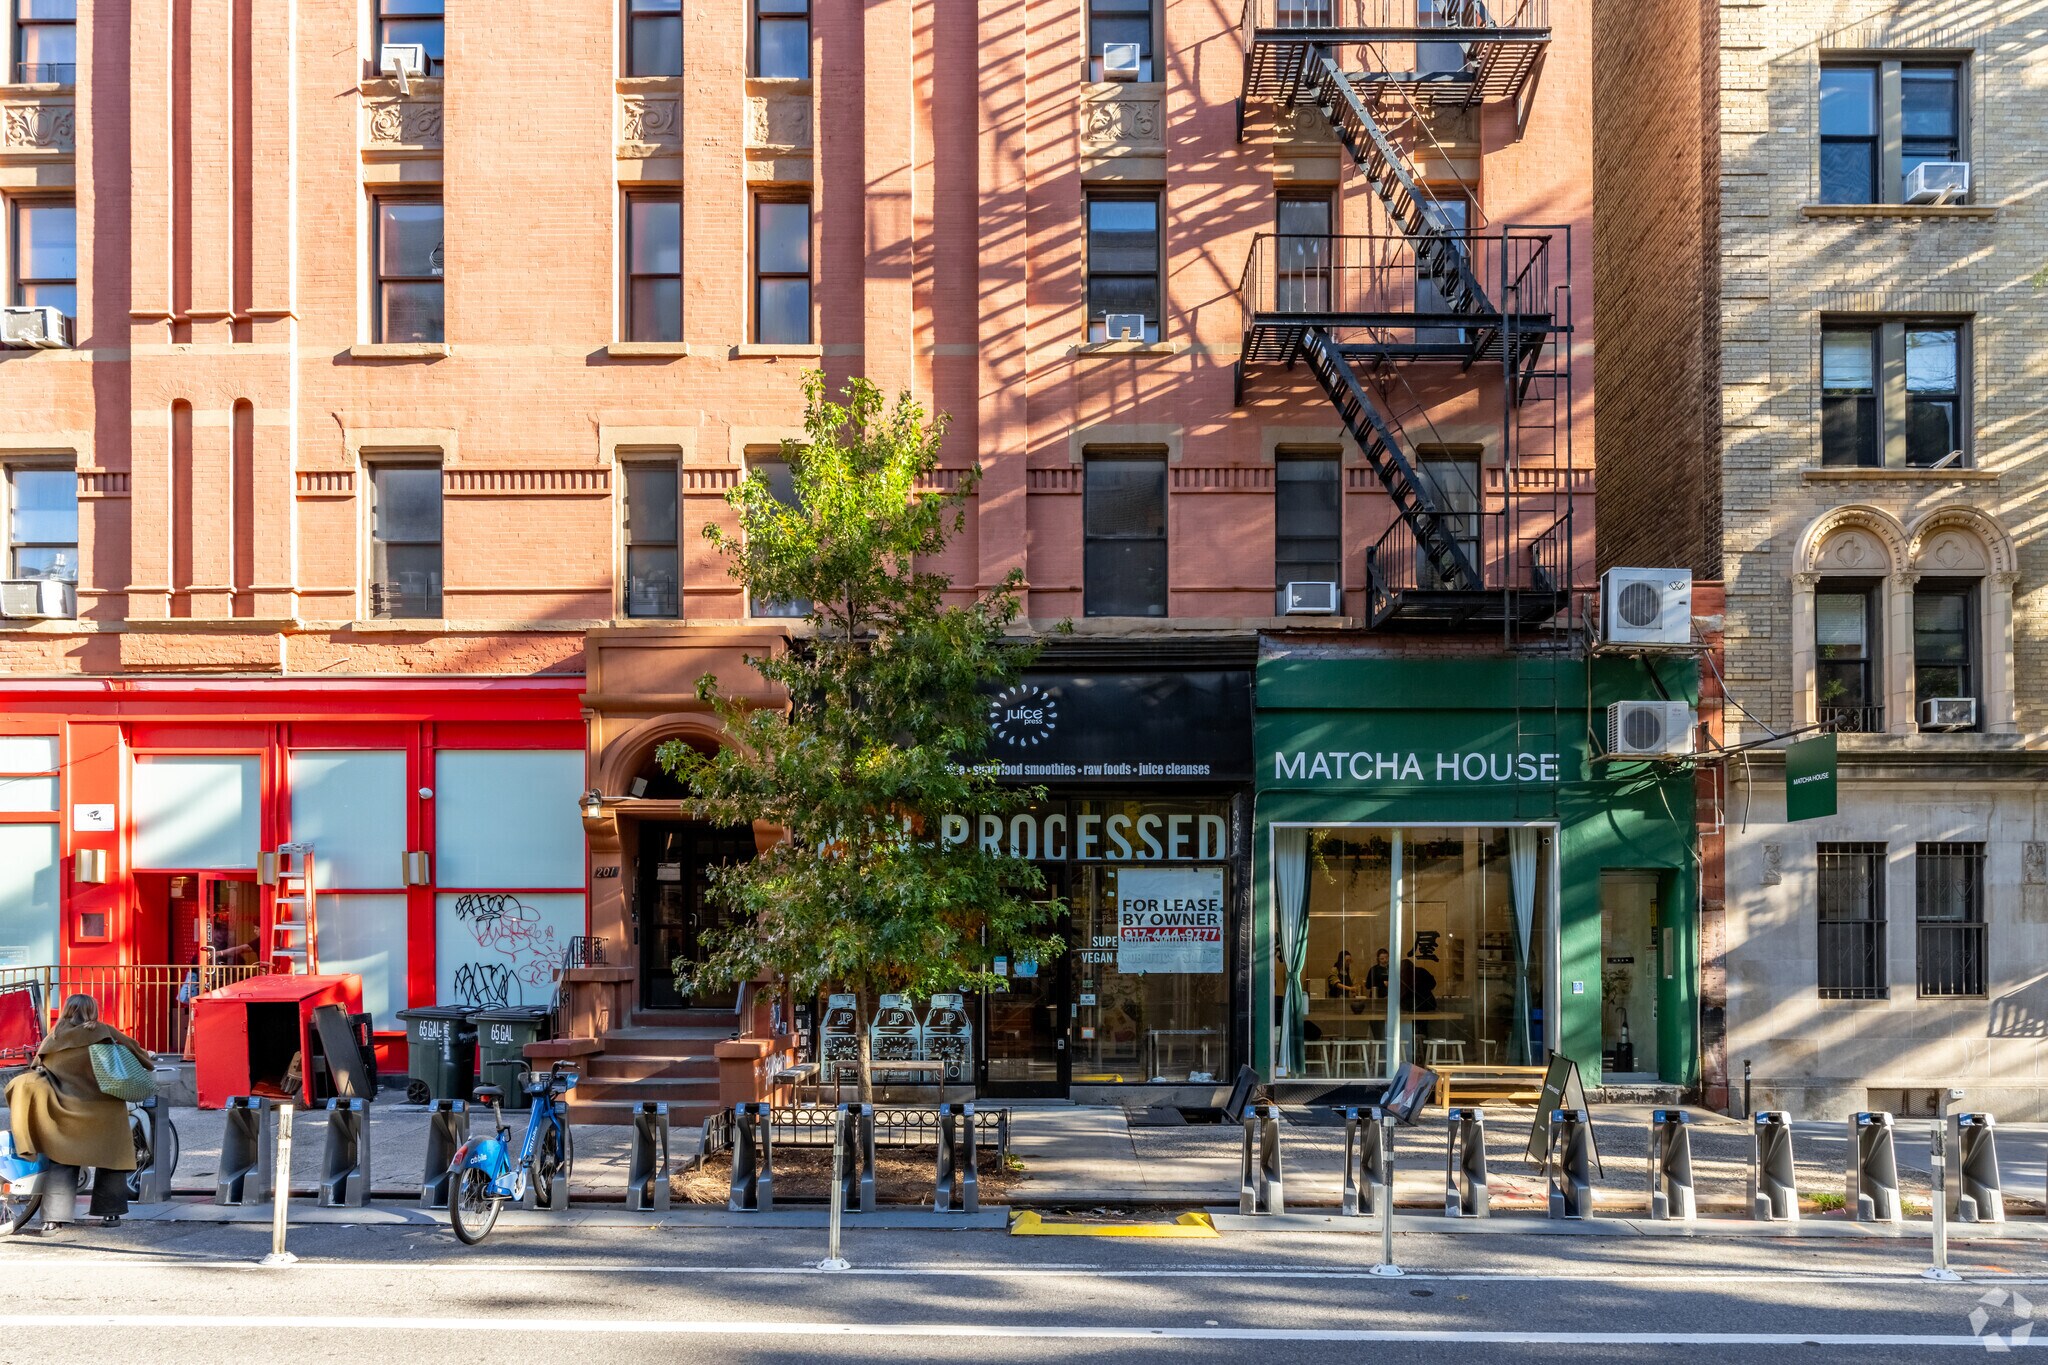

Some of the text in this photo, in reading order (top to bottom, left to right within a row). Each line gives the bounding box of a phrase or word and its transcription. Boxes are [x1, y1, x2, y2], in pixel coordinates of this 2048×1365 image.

[1004, 705, 1043, 722] juice
[1024, 763, 1076, 776] smoothies
[1083, 764, 1101, 775] raw
[1103, 763, 1131, 775] foods
[1138, 763, 1163, 776] juice
[1165, 763, 1210, 775] cleanses
[1275, 751, 1560, 781] MATCHA HOUSE
[1793, 772, 1829, 785] MATCHA HOUSE
[1122, 899, 1218, 912] FOR LEASE
[1123, 913, 1146, 926] BY
[1150, 913, 1218, 926] OWNER
[1123, 928, 1219, 940] 917-444-9777
[1081, 952, 1113, 963] VEGAN
[837, 1012, 853, 1025] JP
[888, 1012, 905, 1025] JP
[939, 1012, 956, 1025] JP
[419, 1020, 428, 1037] 65
[428, 1020, 441, 1038] GAL
[490, 1024, 500, 1041] 65
[500, 1024, 514, 1042] GAL
